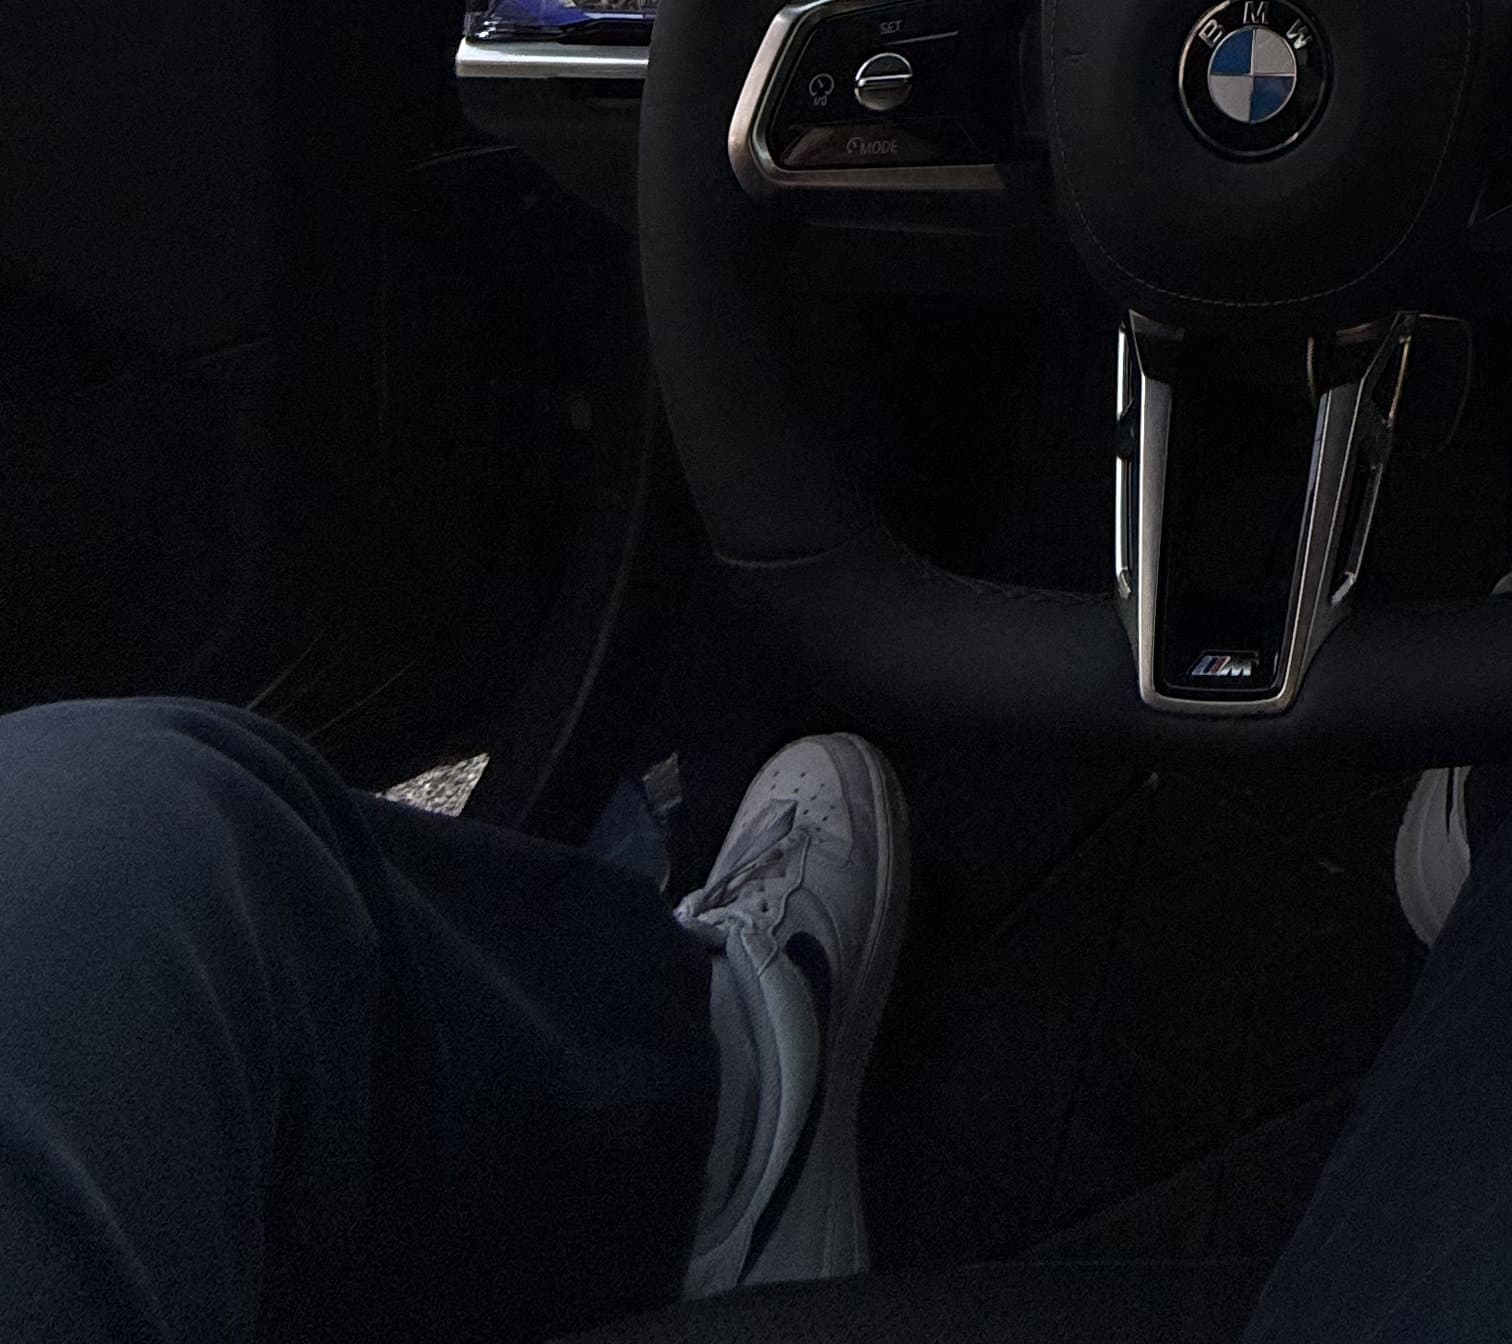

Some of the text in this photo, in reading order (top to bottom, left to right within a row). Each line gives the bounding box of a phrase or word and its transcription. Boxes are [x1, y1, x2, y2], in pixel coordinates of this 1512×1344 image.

[880, 20, 903, 33] SET
[1198, 0, 1312, 49] BMW
[861, 140, 898, 154] MODE
